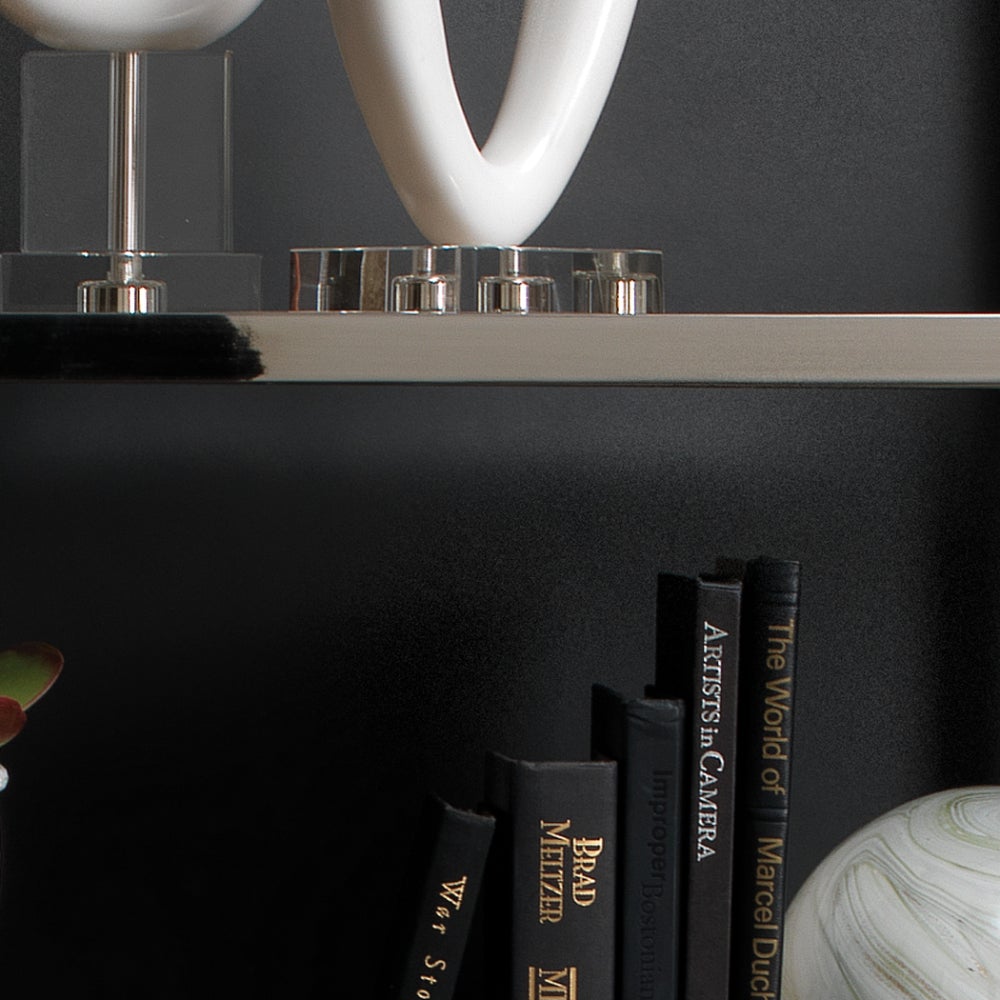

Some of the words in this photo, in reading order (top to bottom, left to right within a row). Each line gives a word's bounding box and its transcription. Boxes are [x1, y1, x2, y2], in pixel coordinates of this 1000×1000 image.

[702, 621, 729, 724] ARTISTS
[766, 619, 795, 671] The
[700, 727, 719, 748] in
[762, 677, 791, 760] World
[697, 751, 725, 862] CAMERA
[761, 768, 786, 796] of
[651, 767, 671, 881] Improper
[432, 875, 467, 935] War
[539, 819, 571, 924] MELTZER
[572, 837, 604, 907] BRAD
[753, 837, 784, 930] Marcel
